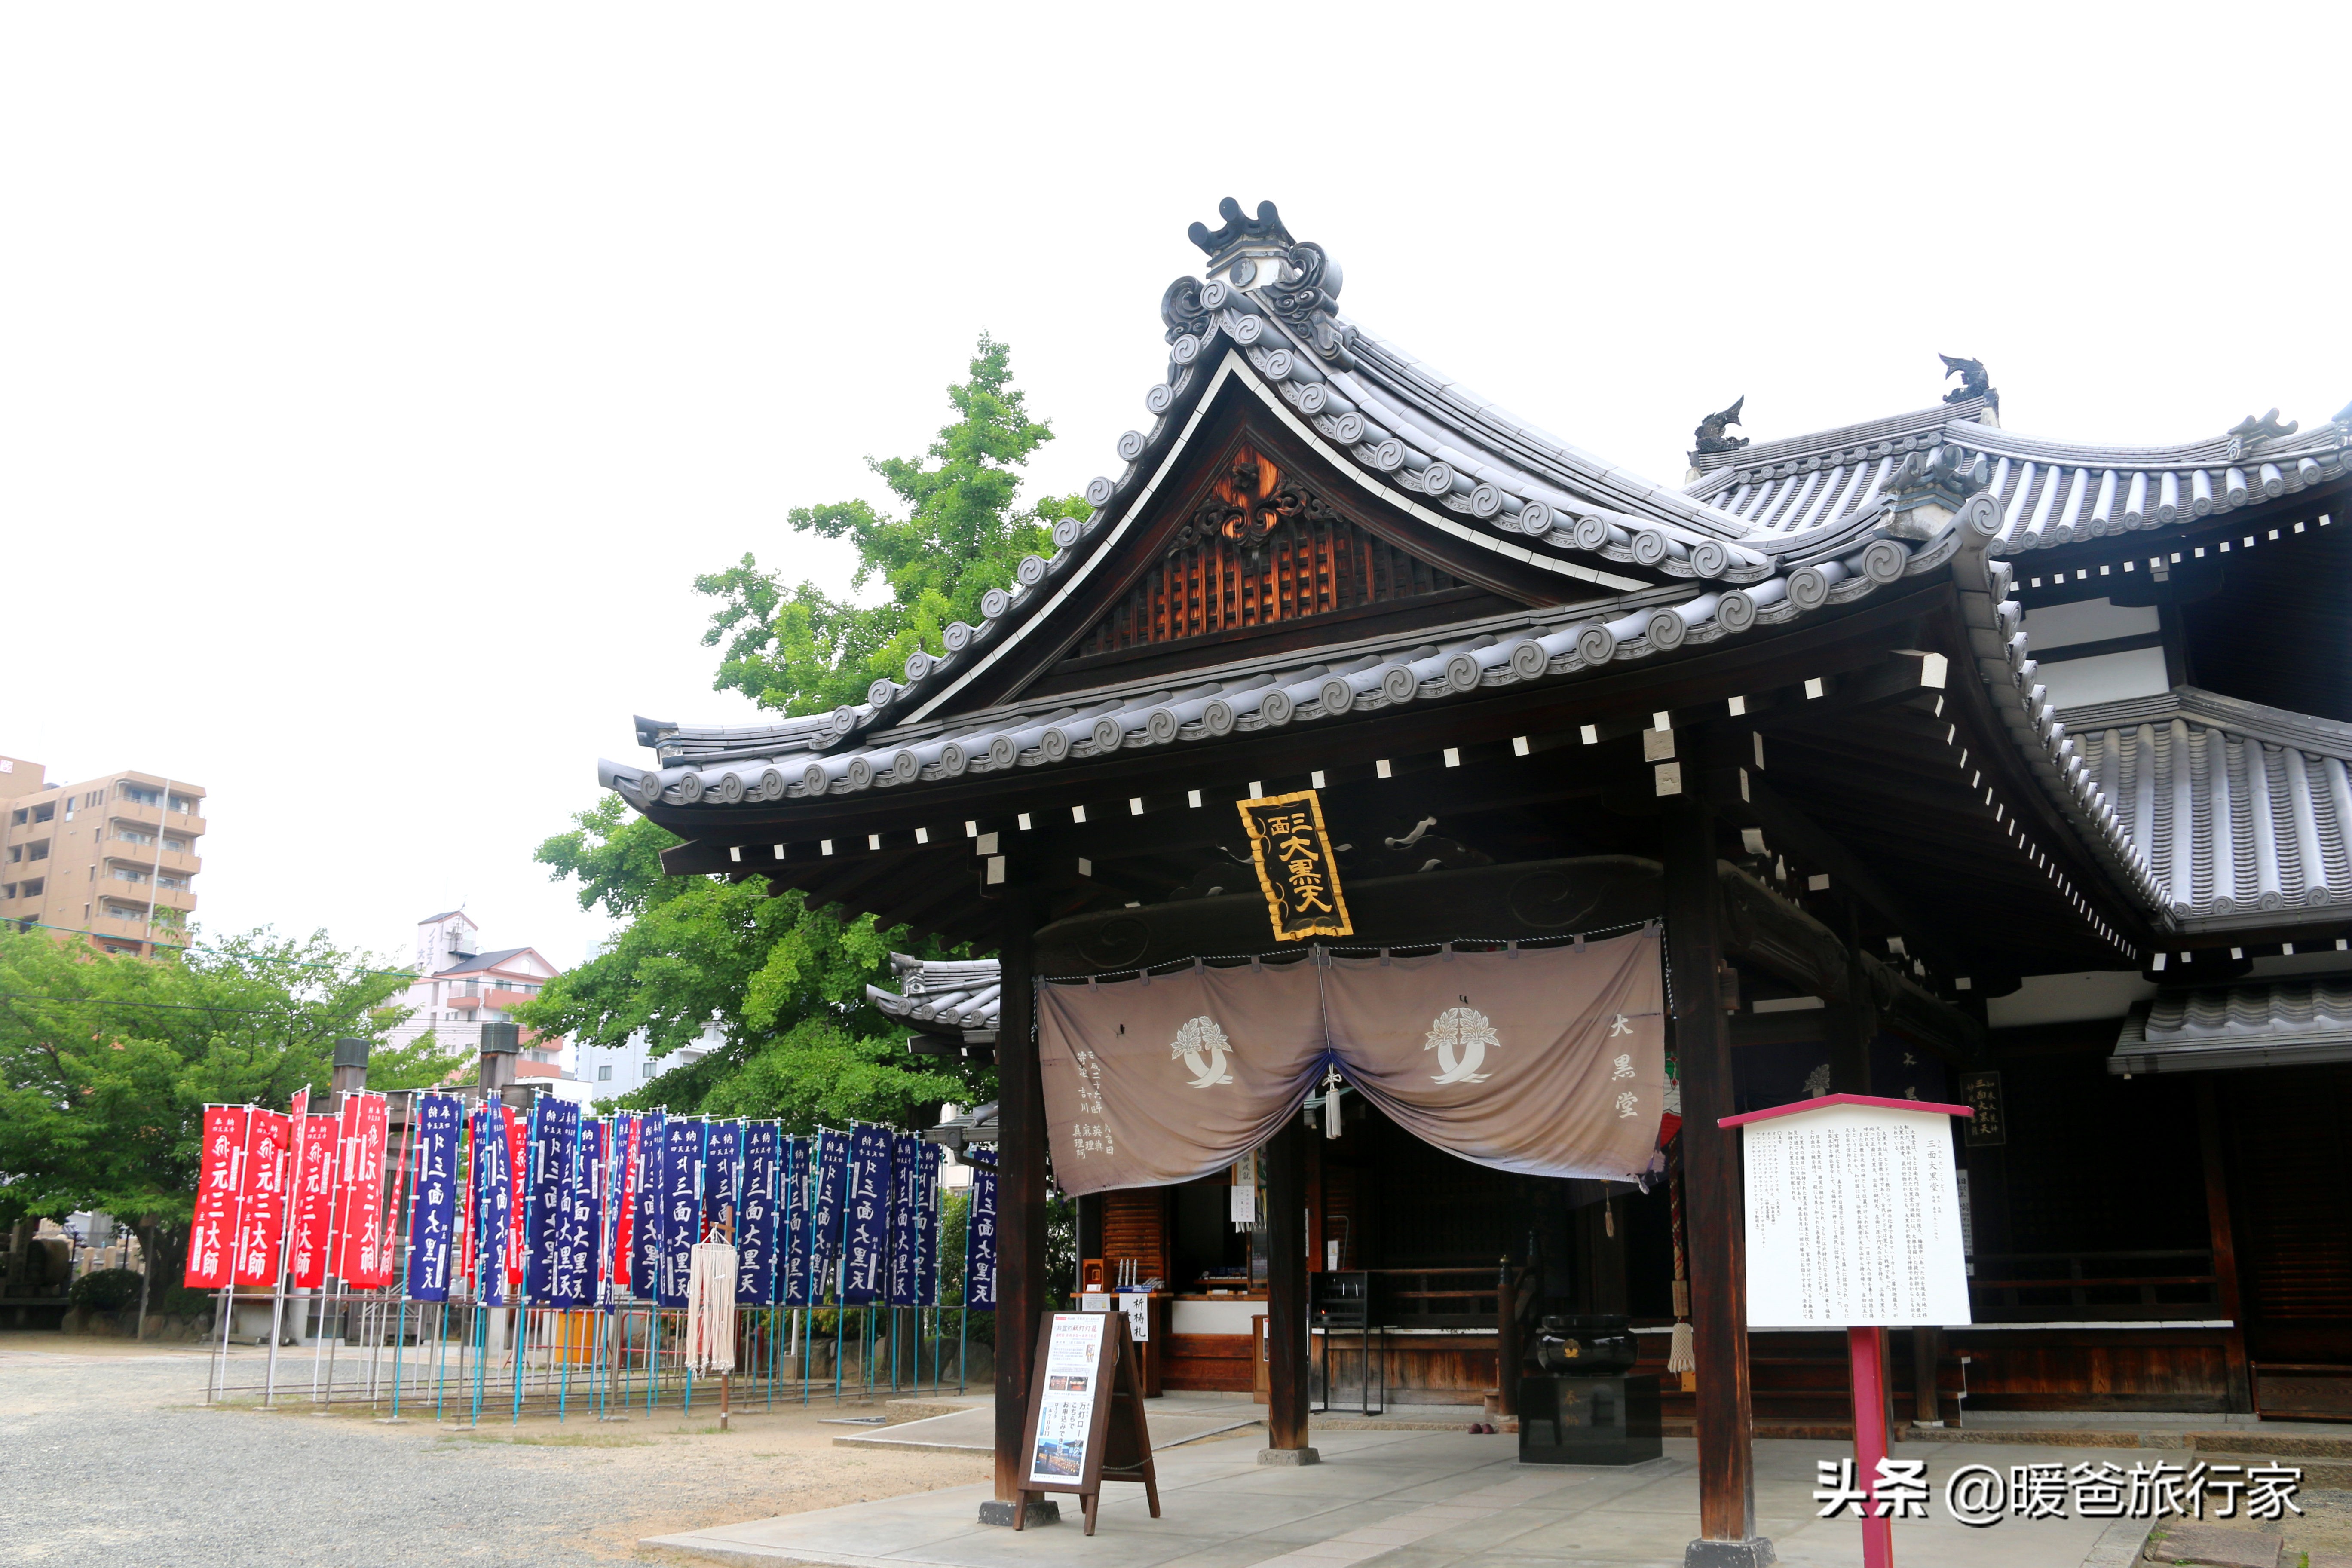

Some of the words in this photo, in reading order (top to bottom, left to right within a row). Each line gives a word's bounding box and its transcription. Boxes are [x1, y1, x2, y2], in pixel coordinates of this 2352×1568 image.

[1268, 813, 1332, 912] 三面大黒天
[426, 928, 435, 965] ノイエス
[1609, 1014, 1638, 1118] 大黒堂
[1976, 1079, 1991, 1133] 三面大黒天
[215, 1118, 235, 1126] 奉納
[671, 1130, 696, 1143] 奉納
[710, 1133, 733, 1147] 奉納
[751, 1132, 771, 1145] 奉納
[1927, 1140, 1939, 1192] 三面大黒堂
[202, 1161, 228, 1280] 元三大師
[247, 1163, 273, 1280] 元三大師
[297, 1166, 320, 1278] 元三大師
[558, 1163, 574, 1297] 三面大黒天
[573, 1176, 591, 1298] 三面大黒天
[672, 1176, 693, 1297] 三面大黒天
[738, 1176, 766, 1293] 三面大黒天
[788, 1191, 803, 1299] 三面大黒天
[894, 1186, 909, 1296] 三面大黒天
[1133, 1298, 1146, 1337] 祈祷札
[1056, 1401, 1069, 1459] お申込みできます
